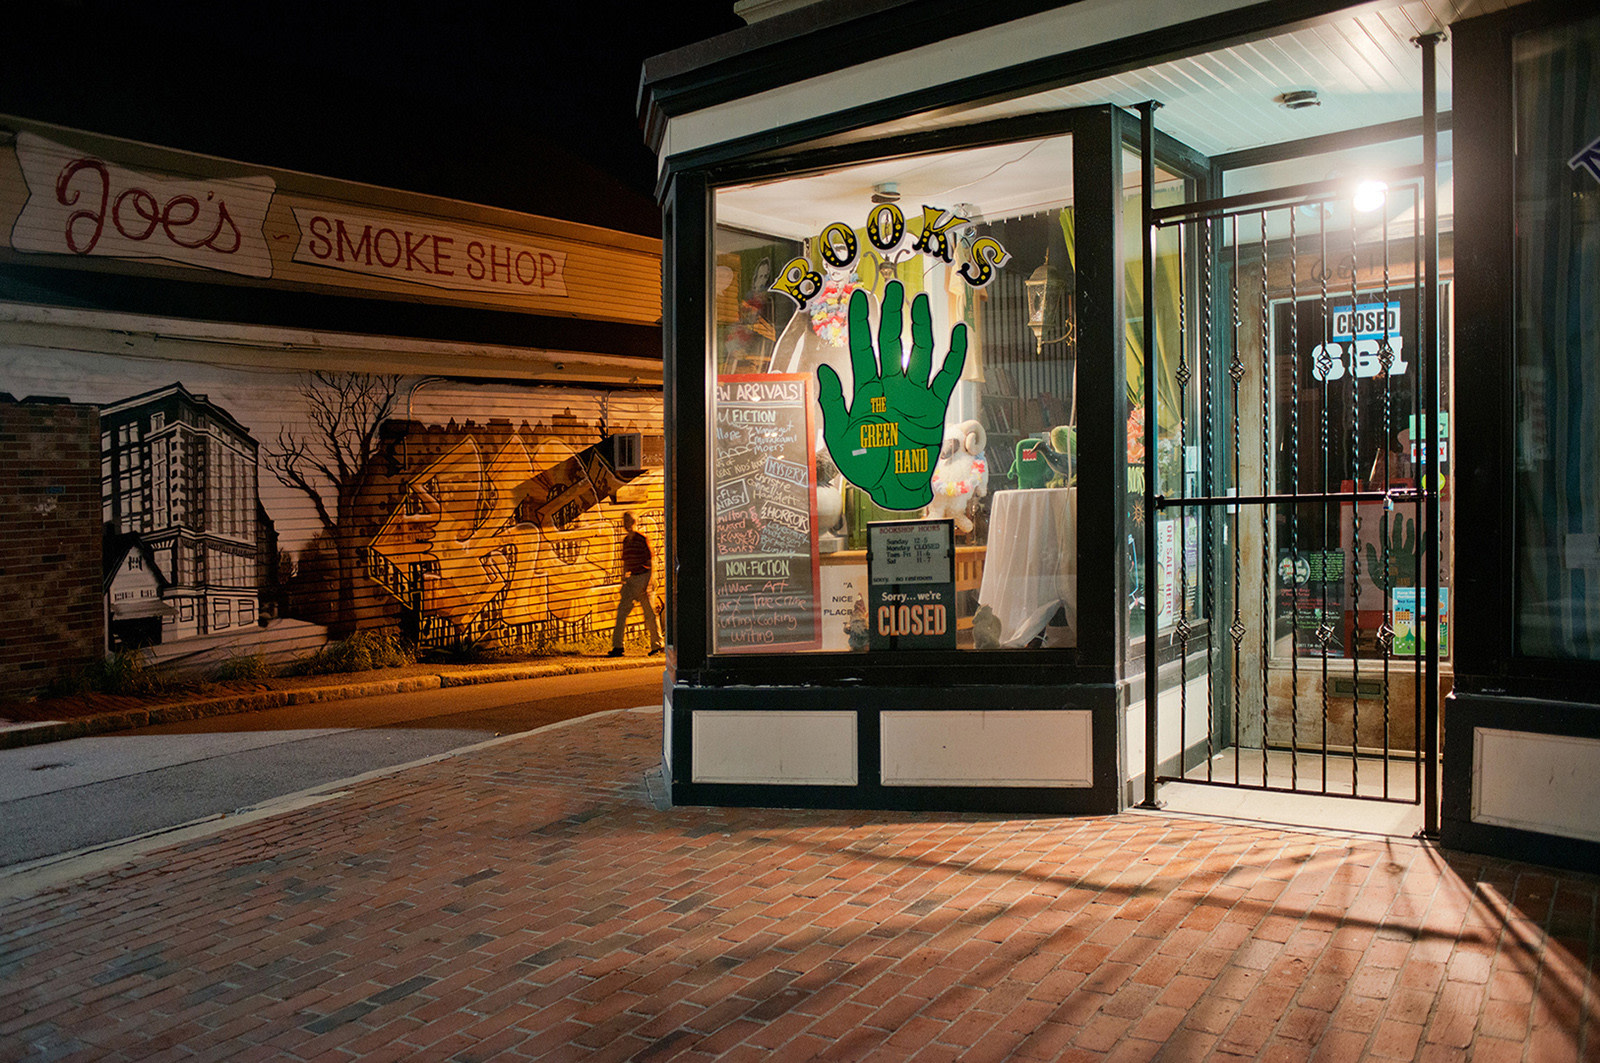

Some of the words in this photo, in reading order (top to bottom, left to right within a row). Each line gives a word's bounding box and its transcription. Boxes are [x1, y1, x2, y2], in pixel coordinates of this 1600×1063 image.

[57, 156, 241, 256] Joe's
[308, 215, 455, 277] SMOKE
[466, 241, 558, 289] SHOP
[768, 203, 1012, 310] BOOKS
[1336, 310, 1397, 335] CLOSED
[736, 383, 803, 401] ARRIVALS!
[732, 409, 776, 422] FICTION
[870, 396, 887, 413] THE
[860, 422, 899, 448] GREEN
[767, 460, 807, 484] MYSTERY
[894, 448, 929, 474] HAND
[766, 506, 807, 531] HORROR
[886, 538, 909, 546] Sunday
[1166, 524, 1173, 543] ON
[725, 560, 790, 576] NON-FICTION
[1165, 546, 1173, 579] SALE
[762, 579, 790, 594] Art
[881, 592, 916, 603] Sorry...
[917, 591, 942, 601] we're
[831, 595, 853, 603] NICE
[878, 604, 947, 636] CLOSED
